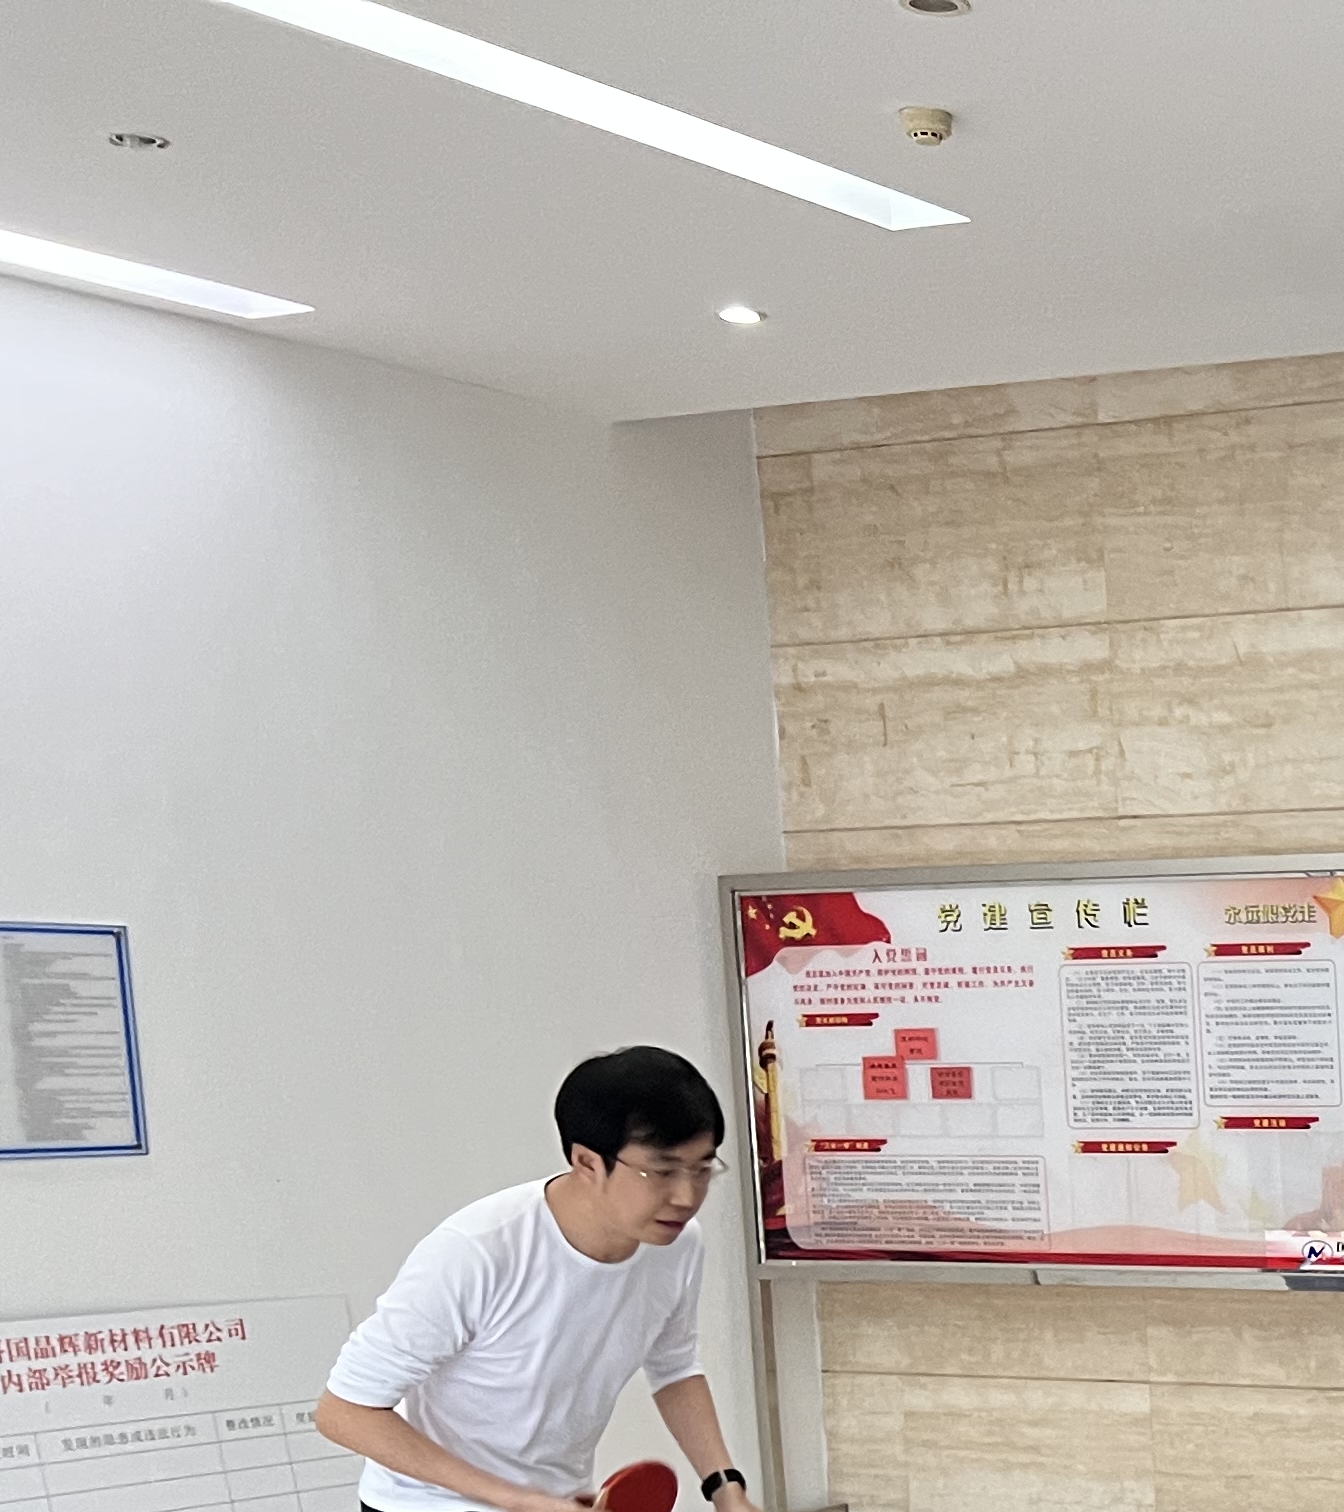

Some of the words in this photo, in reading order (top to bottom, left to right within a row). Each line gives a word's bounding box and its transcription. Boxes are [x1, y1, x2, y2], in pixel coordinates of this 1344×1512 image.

[937, 896, 1149, 933] 党建宣传栏
[0, 1318, 247, 1364] 国晶辉新材料有限公司
